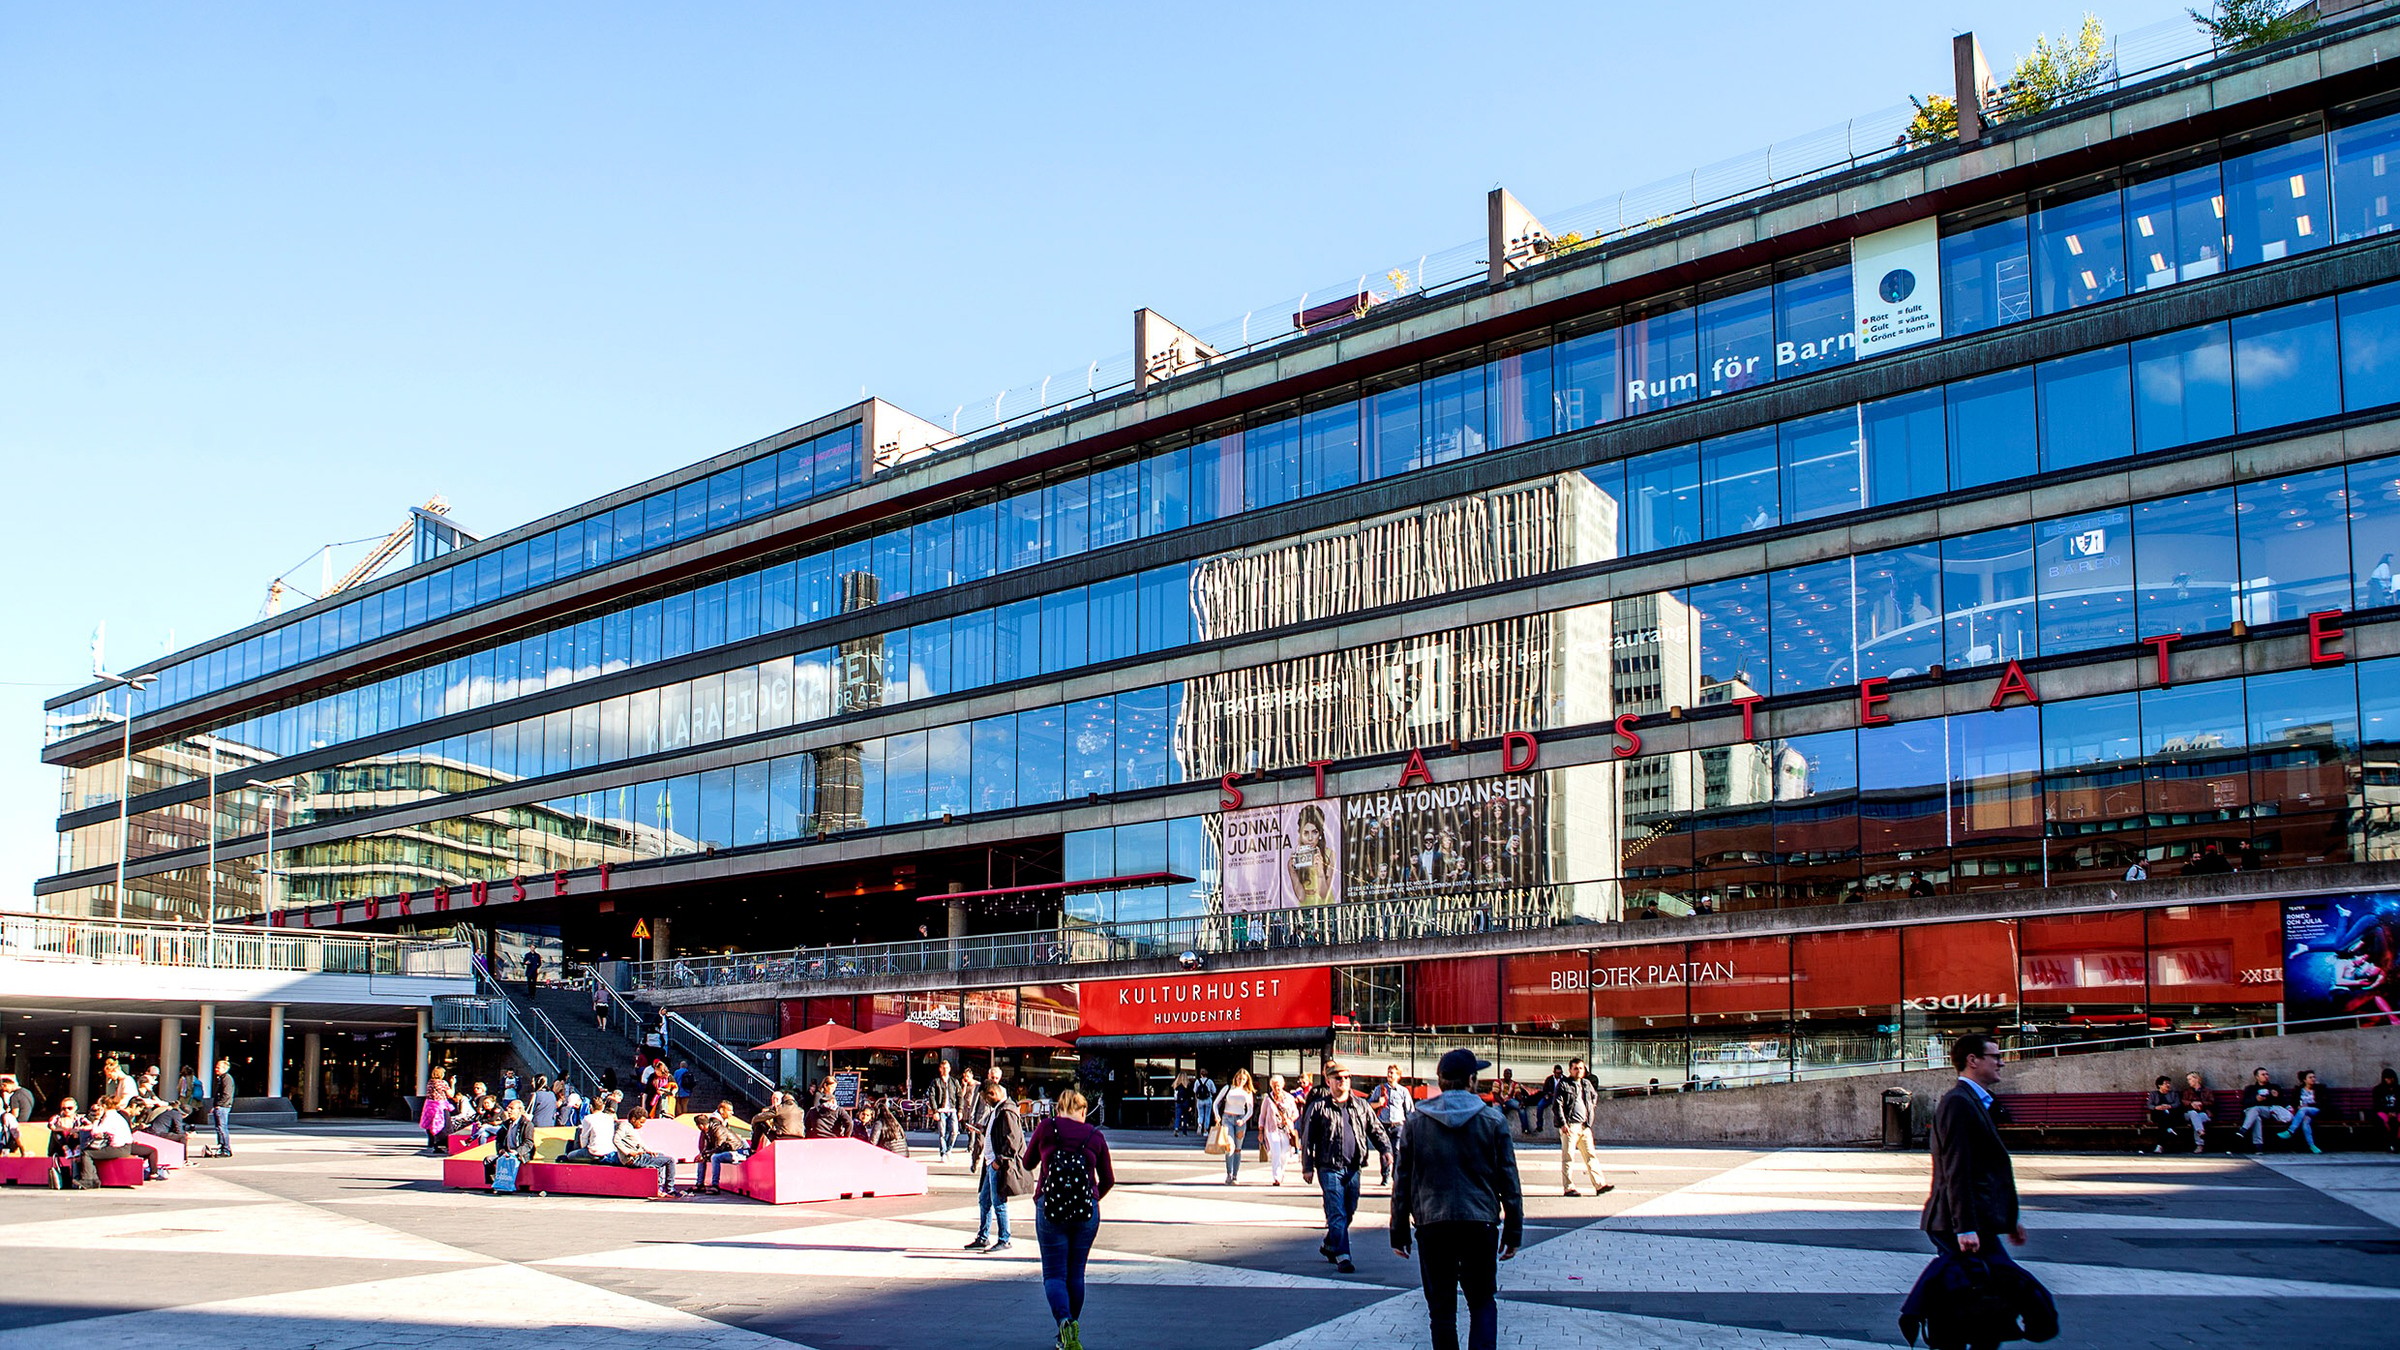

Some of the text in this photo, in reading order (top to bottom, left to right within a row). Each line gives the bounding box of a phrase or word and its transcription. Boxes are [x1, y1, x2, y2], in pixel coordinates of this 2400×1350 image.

[1870, 314, 1889, 323] Rött
[1905, 305, 1922, 314] fullt
[1870, 323, 1889, 332] Gult
[1905, 313, 1929, 324] vänta
[1871, 332, 1896, 342] Grönt
[1906, 324, 1925, 334] kom
[1628, 332, 1855, 403] Rum för Barn
[2049, 556, 2120, 577] BAREN
[1573, 624, 1689, 653] taurang
[330, 663, 457, 718] ATONALMUSEUM
[1346, 777, 1536, 820] MARATONDANSEN
[1228, 818, 1280, 838] DONNA
[1228, 834, 1292, 855] JUANITA
[244, 864, 613, 927] ULTURHUSET
[1551, 960, 1735, 990] BIBLIOTEK PLATTAN
[1119, 979, 1281, 1005] KULTURHUSET
[910, 1008, 961, 1021] KULTURHUSET
[914, 1019, 939, 1029] TORIES
[1154, 1007, 1242, 1024] HUVUDENTRÉ
